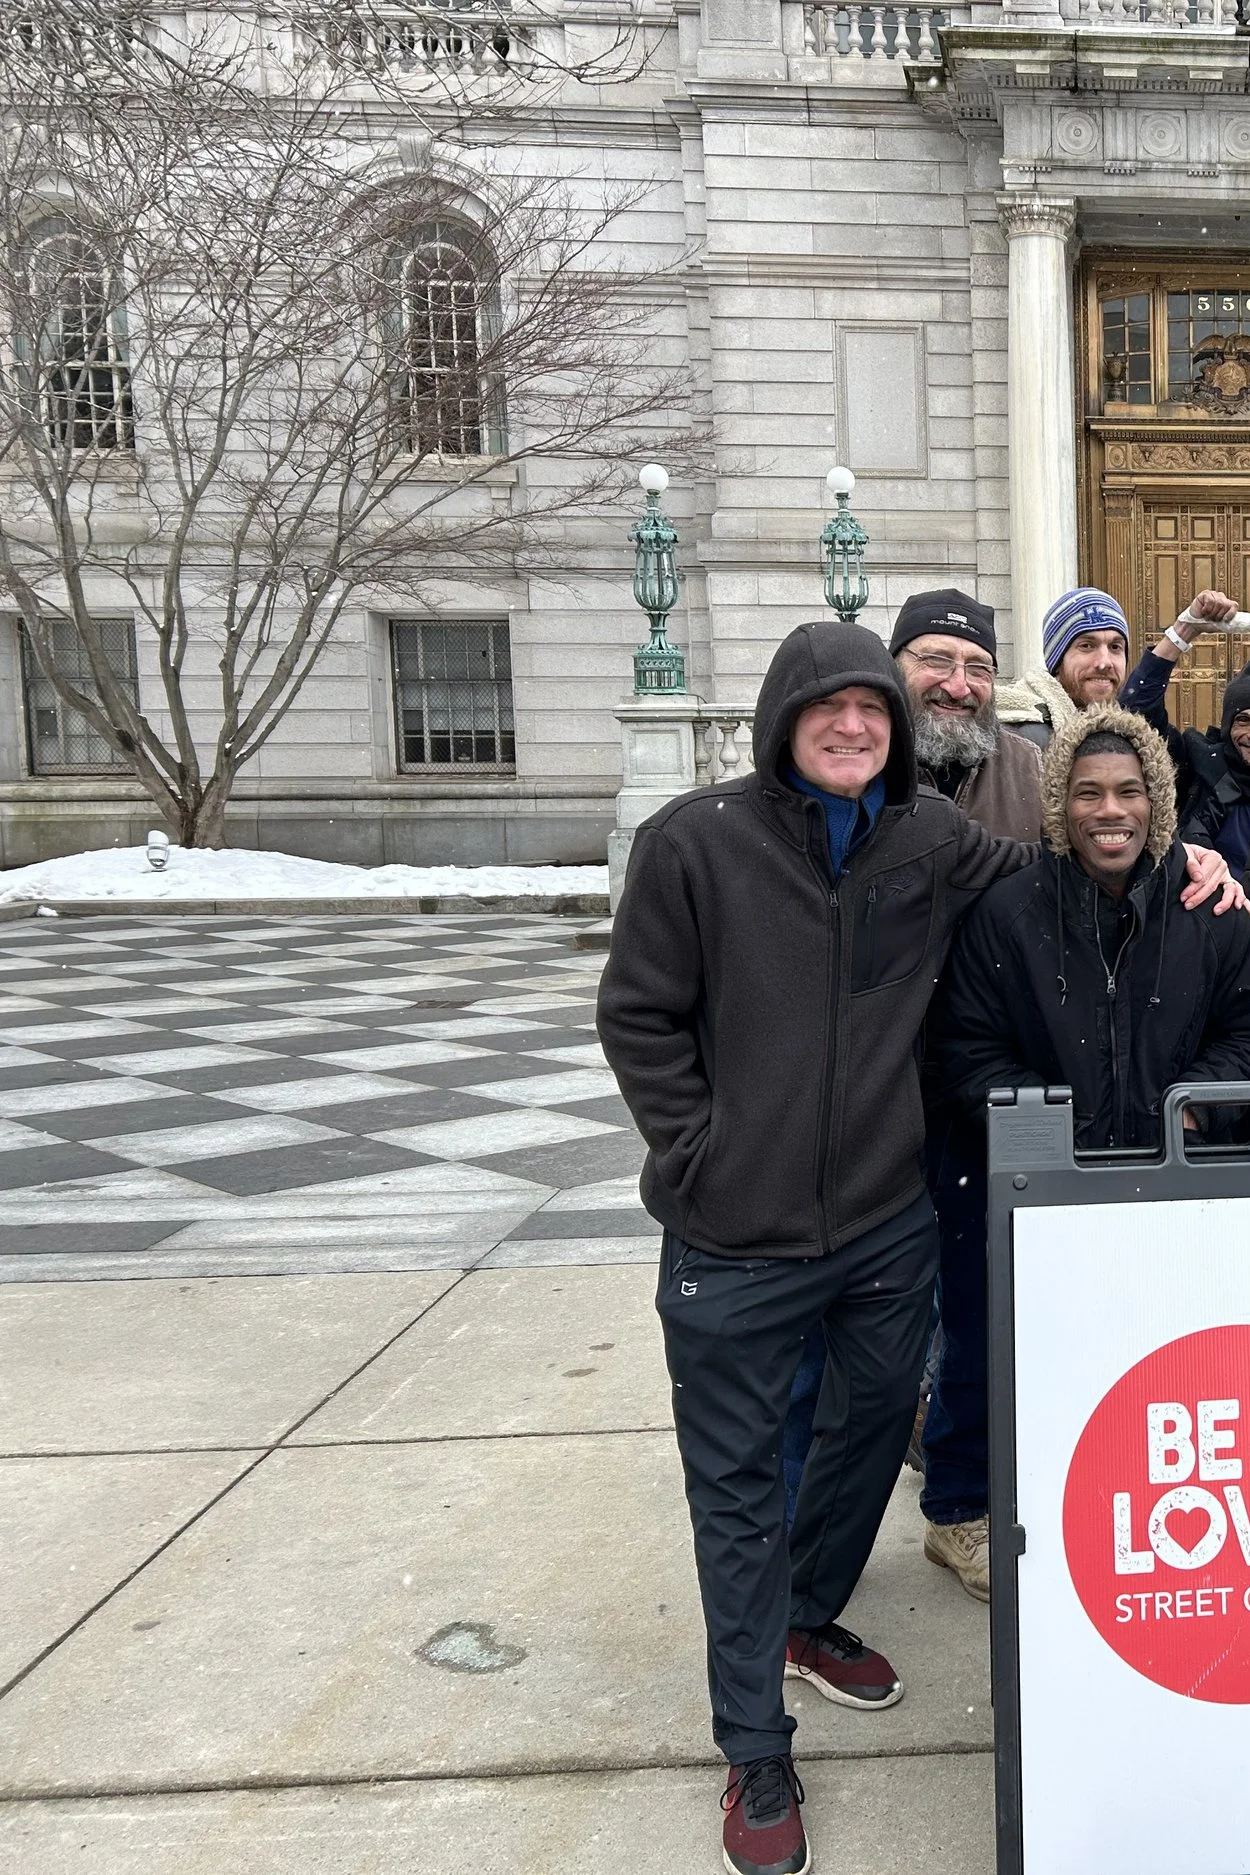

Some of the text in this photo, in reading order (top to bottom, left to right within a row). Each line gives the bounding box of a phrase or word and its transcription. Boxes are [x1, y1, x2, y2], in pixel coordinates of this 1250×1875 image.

[930, 619, 960, 627] mount
[1147, 1398, 1243, 1485] BE
[1115, 1587, 1234, 1624] STREET
